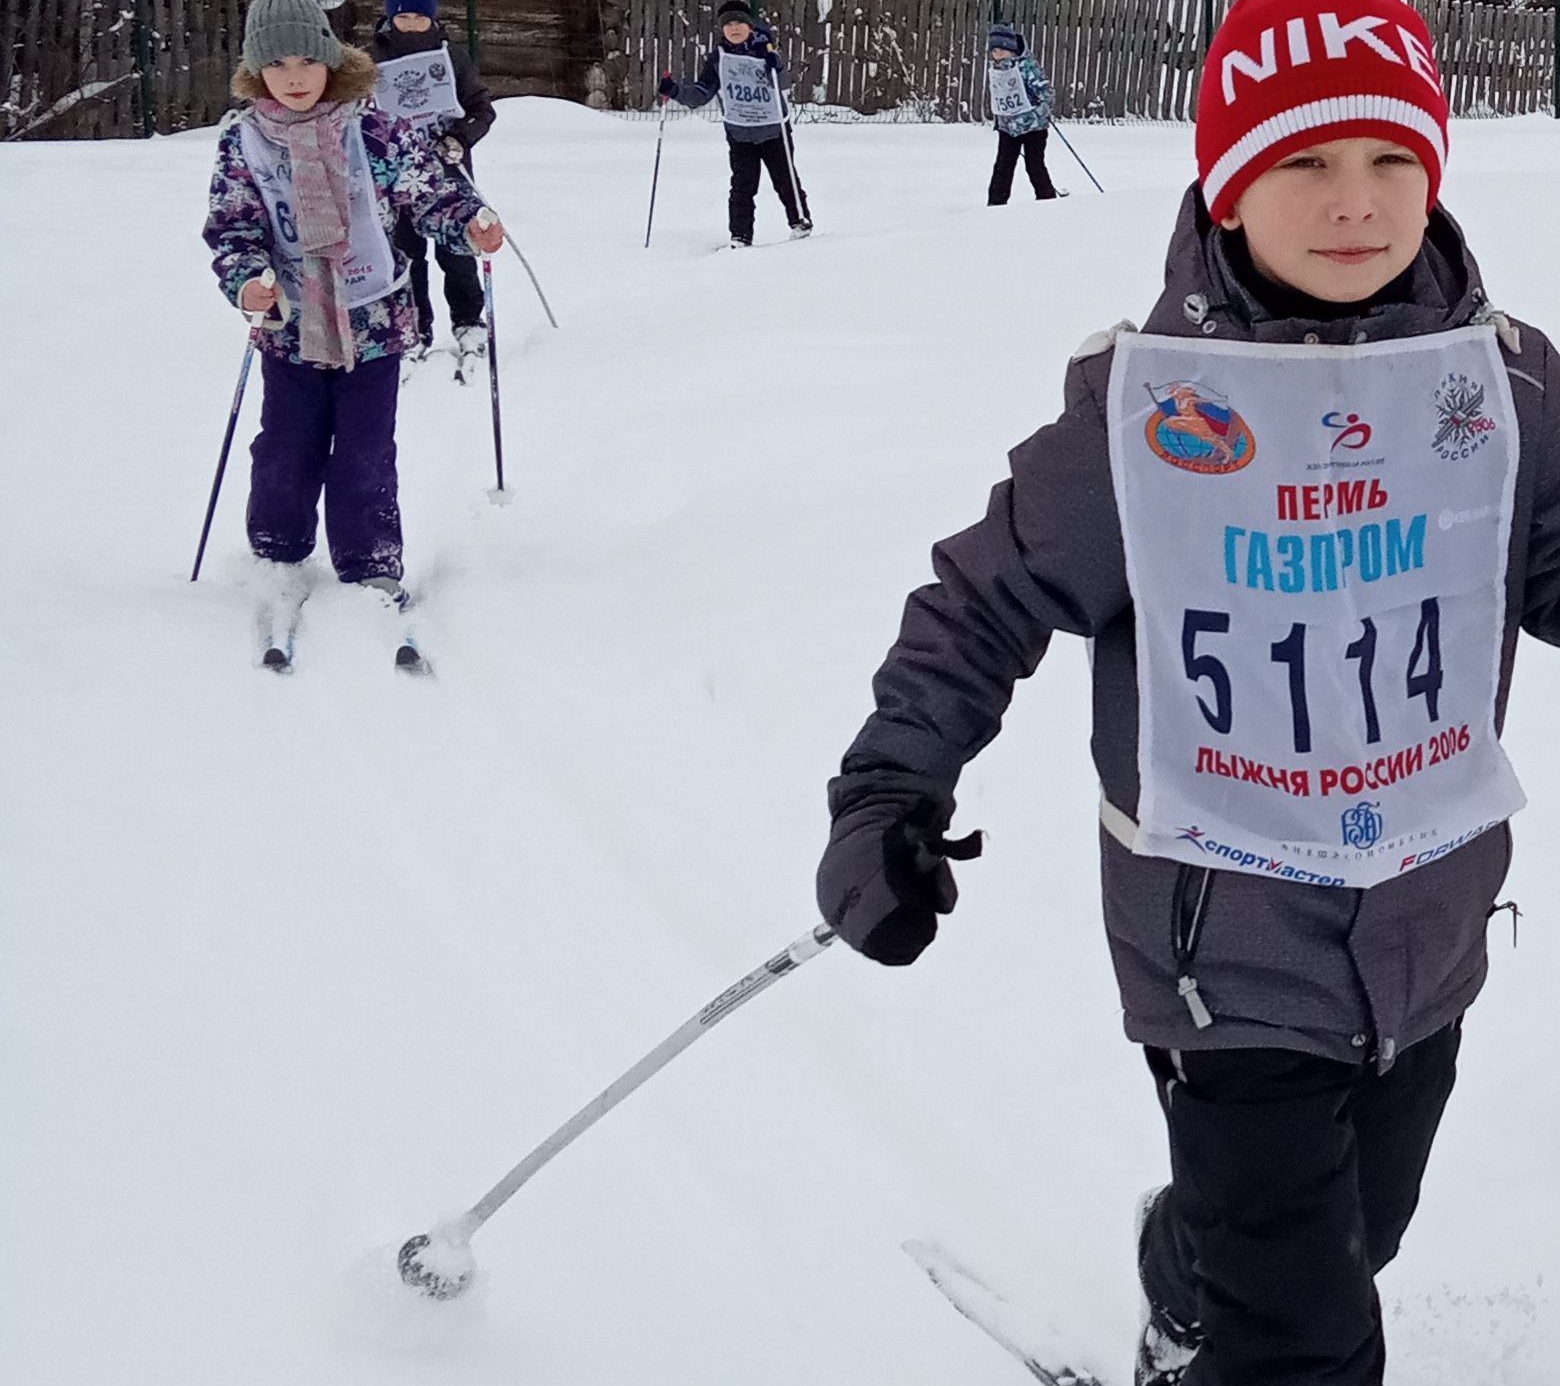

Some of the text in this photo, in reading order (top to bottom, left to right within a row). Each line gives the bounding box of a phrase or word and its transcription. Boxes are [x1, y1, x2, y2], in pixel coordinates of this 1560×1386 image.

[726, 82, 771, 103] 12840
[1222, 13, 1440, 106] NIKE
[1277, 478, 1388, 521] ПЕРМЬ
[1224, 514, 1428, 594] ГАЗПРОМ
[1181, 596, 1445, 754] 5114
[1195, 723, 1471, 797] ЛЫЖНЯ РОССИИ 2006
